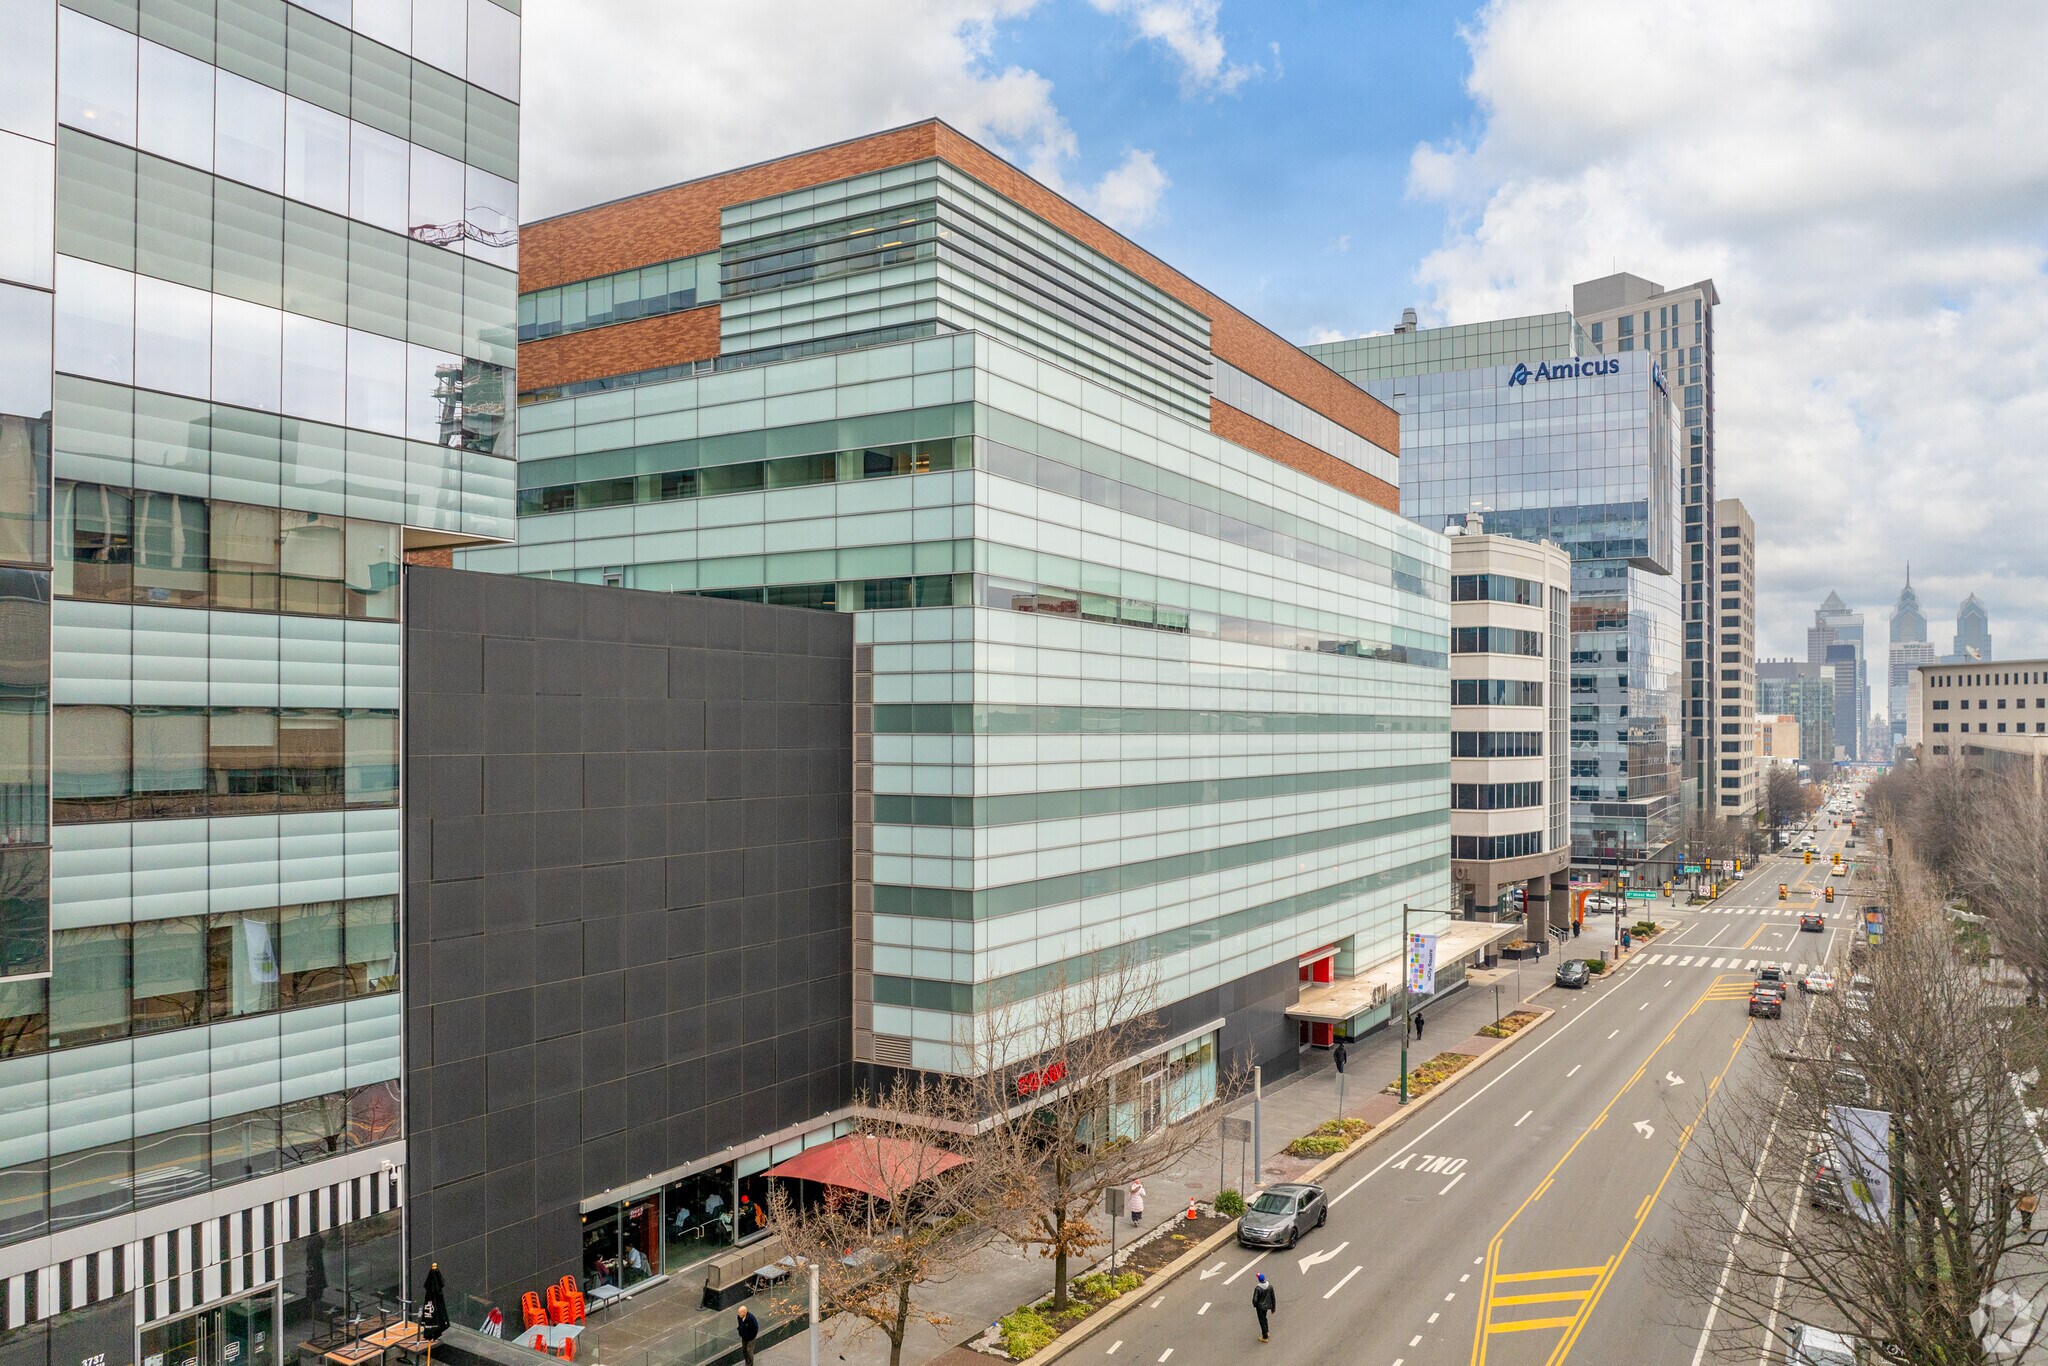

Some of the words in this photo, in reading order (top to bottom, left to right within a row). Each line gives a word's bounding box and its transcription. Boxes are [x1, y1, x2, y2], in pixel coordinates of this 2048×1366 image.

[1534, 357, 1619, 381] Amicus
[1391, 1153, 1468, 1175] ONLY
[82, 1353, 105, 1366] 3737
